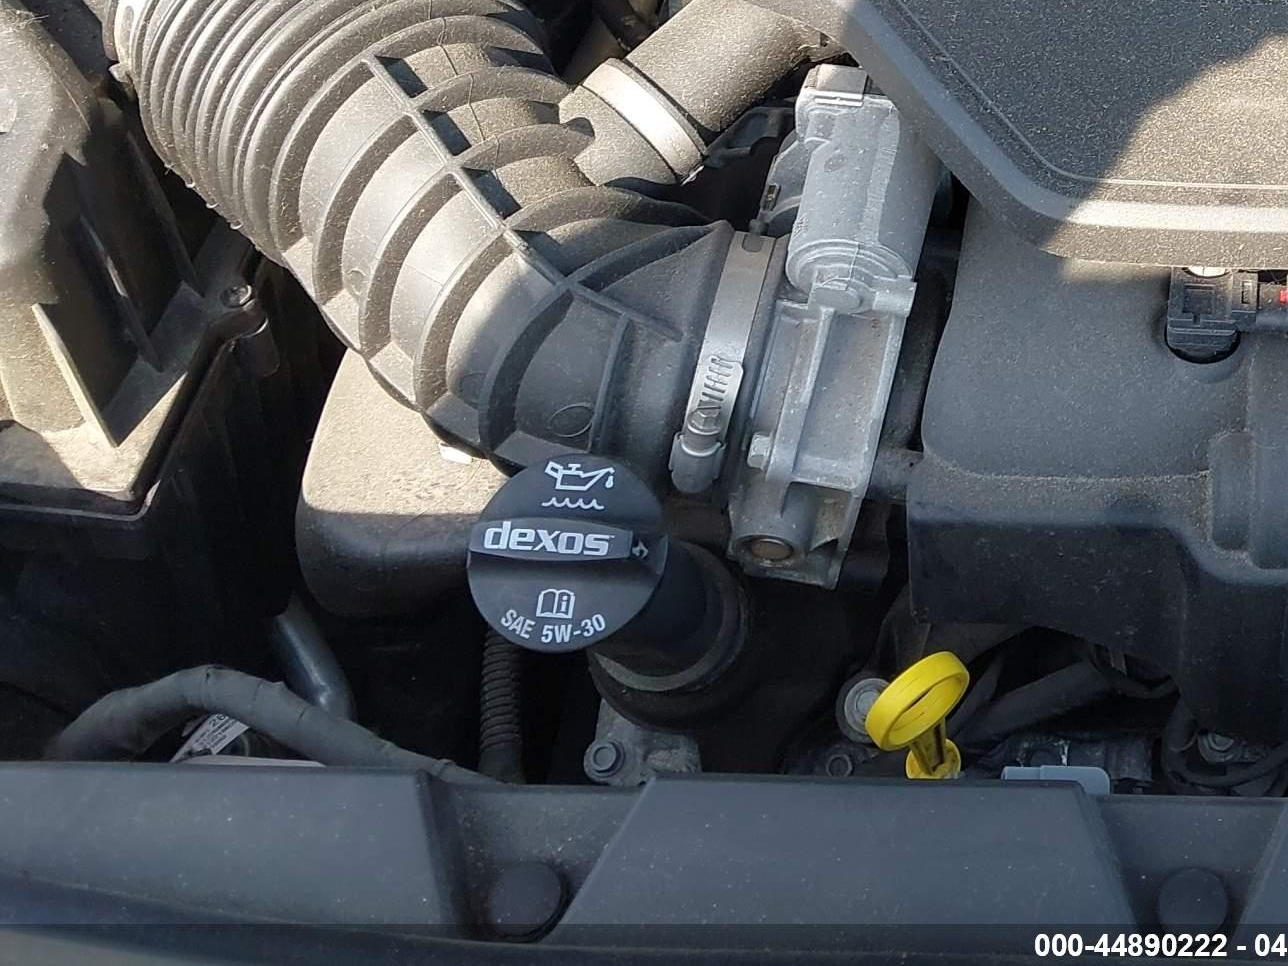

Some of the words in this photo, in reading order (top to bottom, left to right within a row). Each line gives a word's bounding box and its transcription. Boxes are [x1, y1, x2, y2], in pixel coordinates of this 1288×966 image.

[484, 520, 611, 557] dexos
[500, 608, 536, 639] SAE
[540, 613, 606, 644] 5W-30
